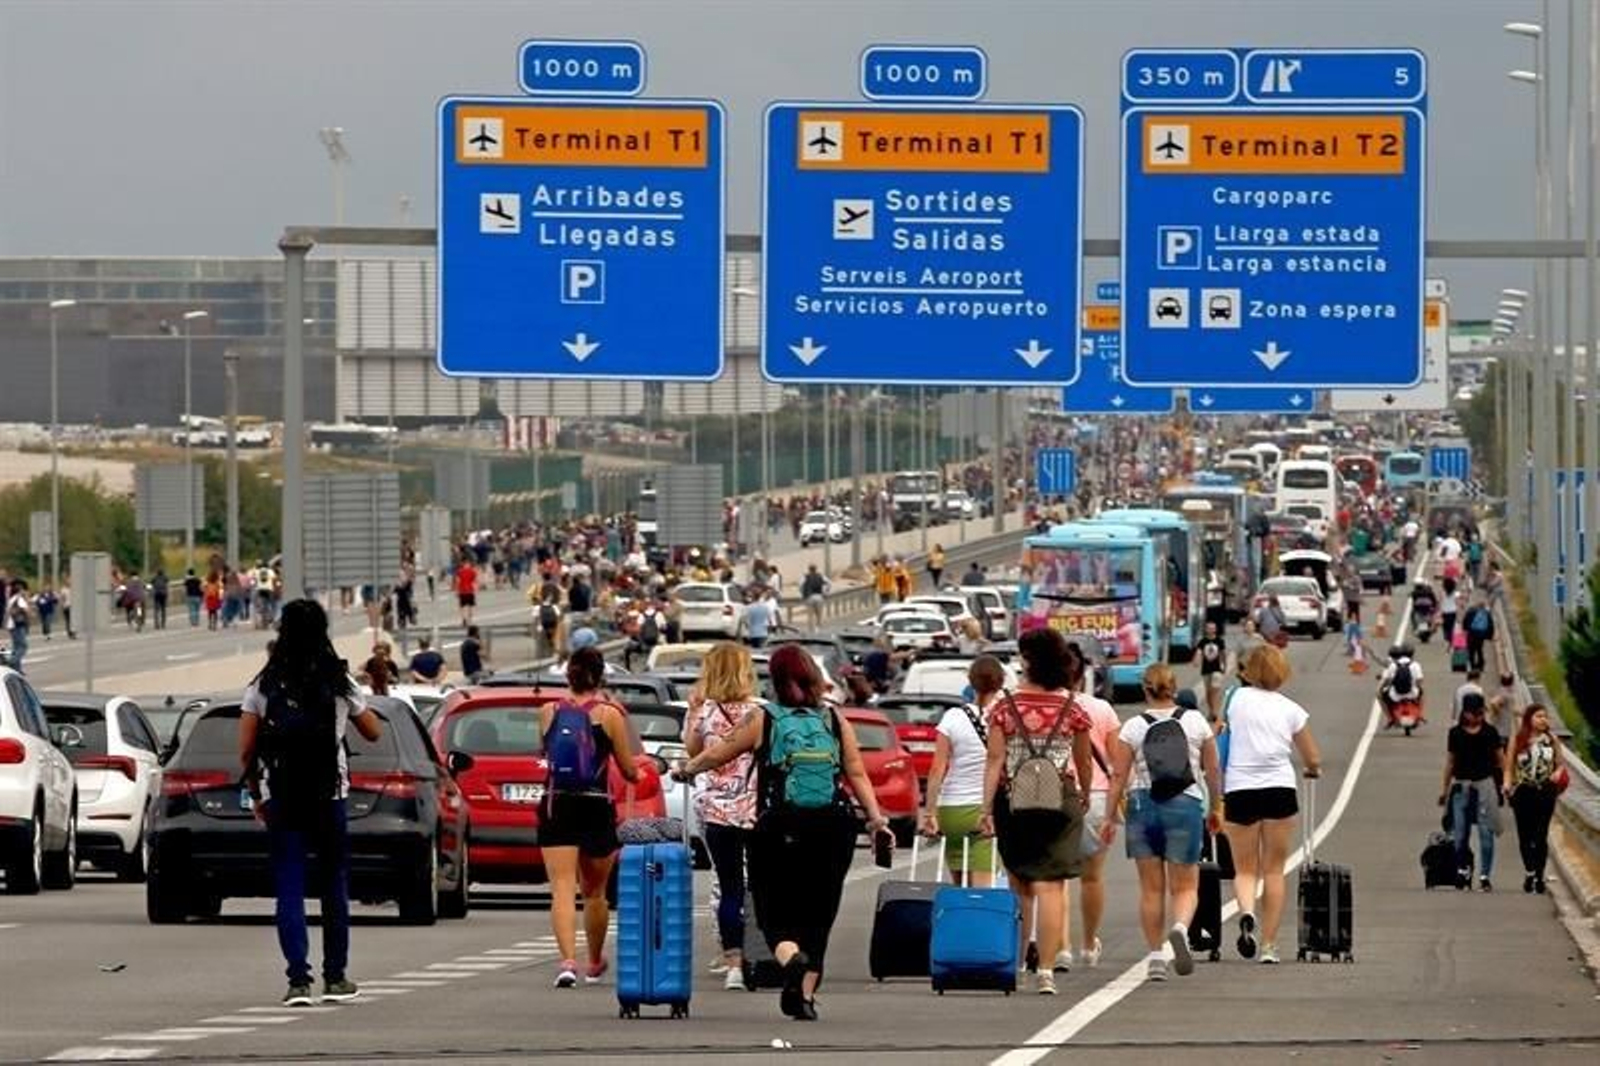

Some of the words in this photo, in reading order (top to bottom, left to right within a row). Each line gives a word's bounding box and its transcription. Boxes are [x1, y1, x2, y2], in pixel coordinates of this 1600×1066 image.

[533, 59, 599, 79] 1000
[612, 64, 634, 79] m
[875, 64, 940, 84] 1000
[953, 69, 974, 84] m
[1139, 67, 1190, 86] 350
[1203, 72, 1224, 86] m
[1395, 68, 1410, 86] 5
[514, 128, 651, 152] Terminal
[668, 129, 701, 152] T1
[858, 131, 993, 155] Terminal
[1010, 131, 1044, 155] T1
[1202, 135, 1339, 158] Terminal
[1356, 133, 1399, 158] T2
[532, 184, 684, 209] Arribades
[885, 188, 1013, 213] Sortides
[1212, 187, 1333, 208] Cargoparc
[539, 224, 676, 249] Llegadas
[893, 228, 1005, 252] Salidas
[1214, 225, 1290, 245] Llarga
[1301, 226, 1380, 243] estada
[1164, 232, 1193, 264] P
[1207, 255, 1273, 275] Larga
[1285, 256, 1387, 273] estancia
[569, 264, 597, 298] P
[821, 266, 907, 285] Serveis
[919, 268, 1024, 289] Aeroport
[795, 296, 904, 315] Servicios
[916, 299, 1049, 320] Aeropuerto
[1249, 300, 1307, 318] Zona
[1319, 303, 1397, 323] espera
